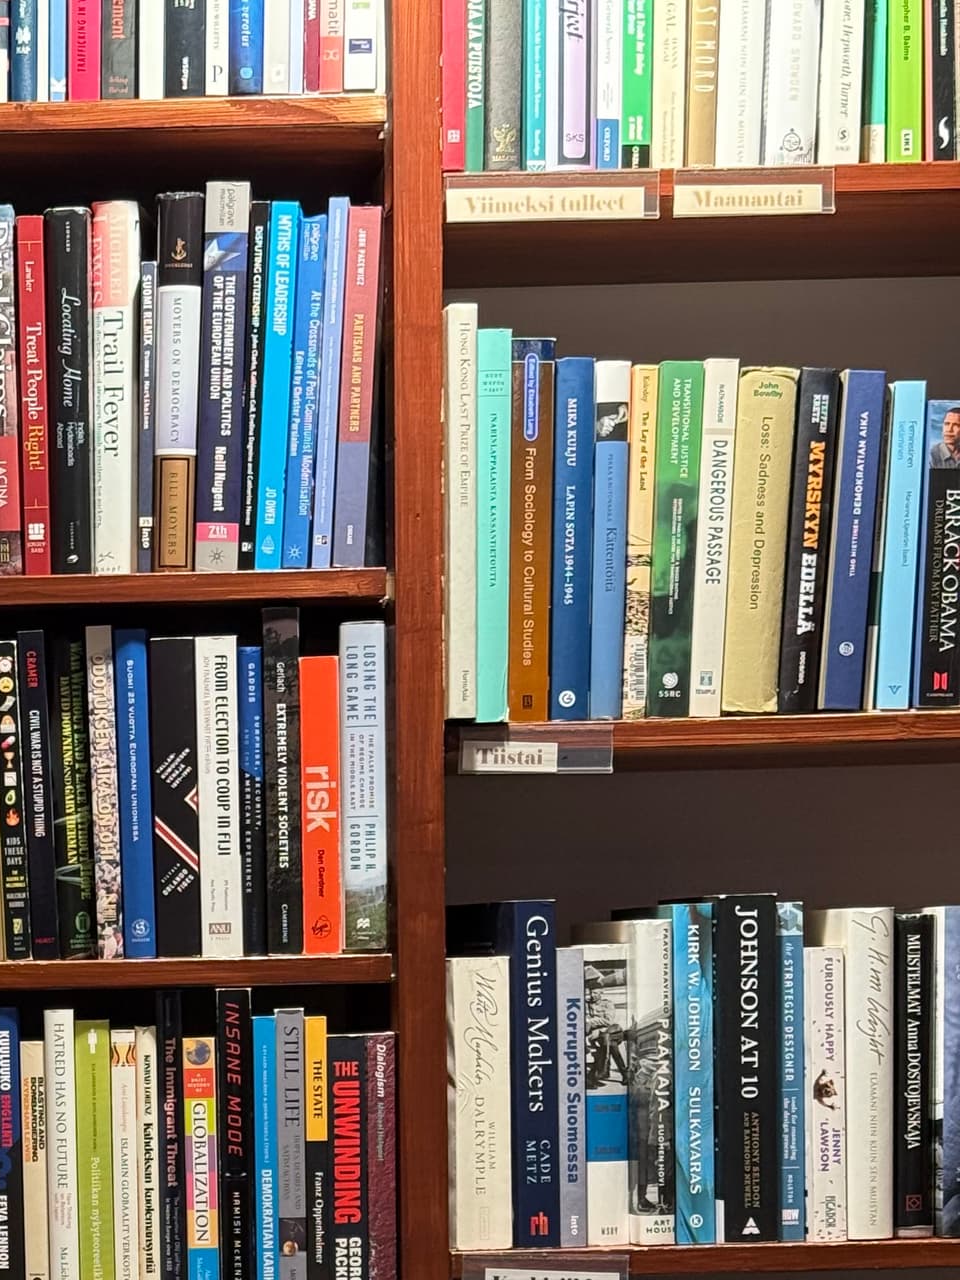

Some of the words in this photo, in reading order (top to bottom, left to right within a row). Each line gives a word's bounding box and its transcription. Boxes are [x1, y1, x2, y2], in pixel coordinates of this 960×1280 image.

[693, 190, 804, 209] Maanantai
[26, 322, 43, 366] Treat
[103, 312, 123, 373] Trail
[26, 370, 44, 420] People
[104, 380, 125, 458] Fever
[26, 424, 45, 471] Right!
[711, 439, 728, 523] DANGEROUS
[801, 442, 826, 549] MYRSKYN
[705, 527, 722, 585] PASSAGE
[796, 553, 818, 635] EDELLÄ
[476, 746, 544, 767] Tiistai
[305, 766, 336, 833] risk
[525, 915, 549, 1007] Genius
[735, 905, 759, 1029] JOHNSON
[225, 1001, 241, 1085] INSANE
[333, 1061, 359, 1076] THE
[527, 1016, 554, 1113] Makers
[565, 998, 581, 1089] Korruptio
[740, 1036, 758, 1069] AT
[740, 1076, 759, 1100] 10
[192, 1102, 210, 1243] GLOBALIZATION
[333, 1080, 363, 1225] UNWINDING
[565, 1092, 581, 1185] Suomessa
